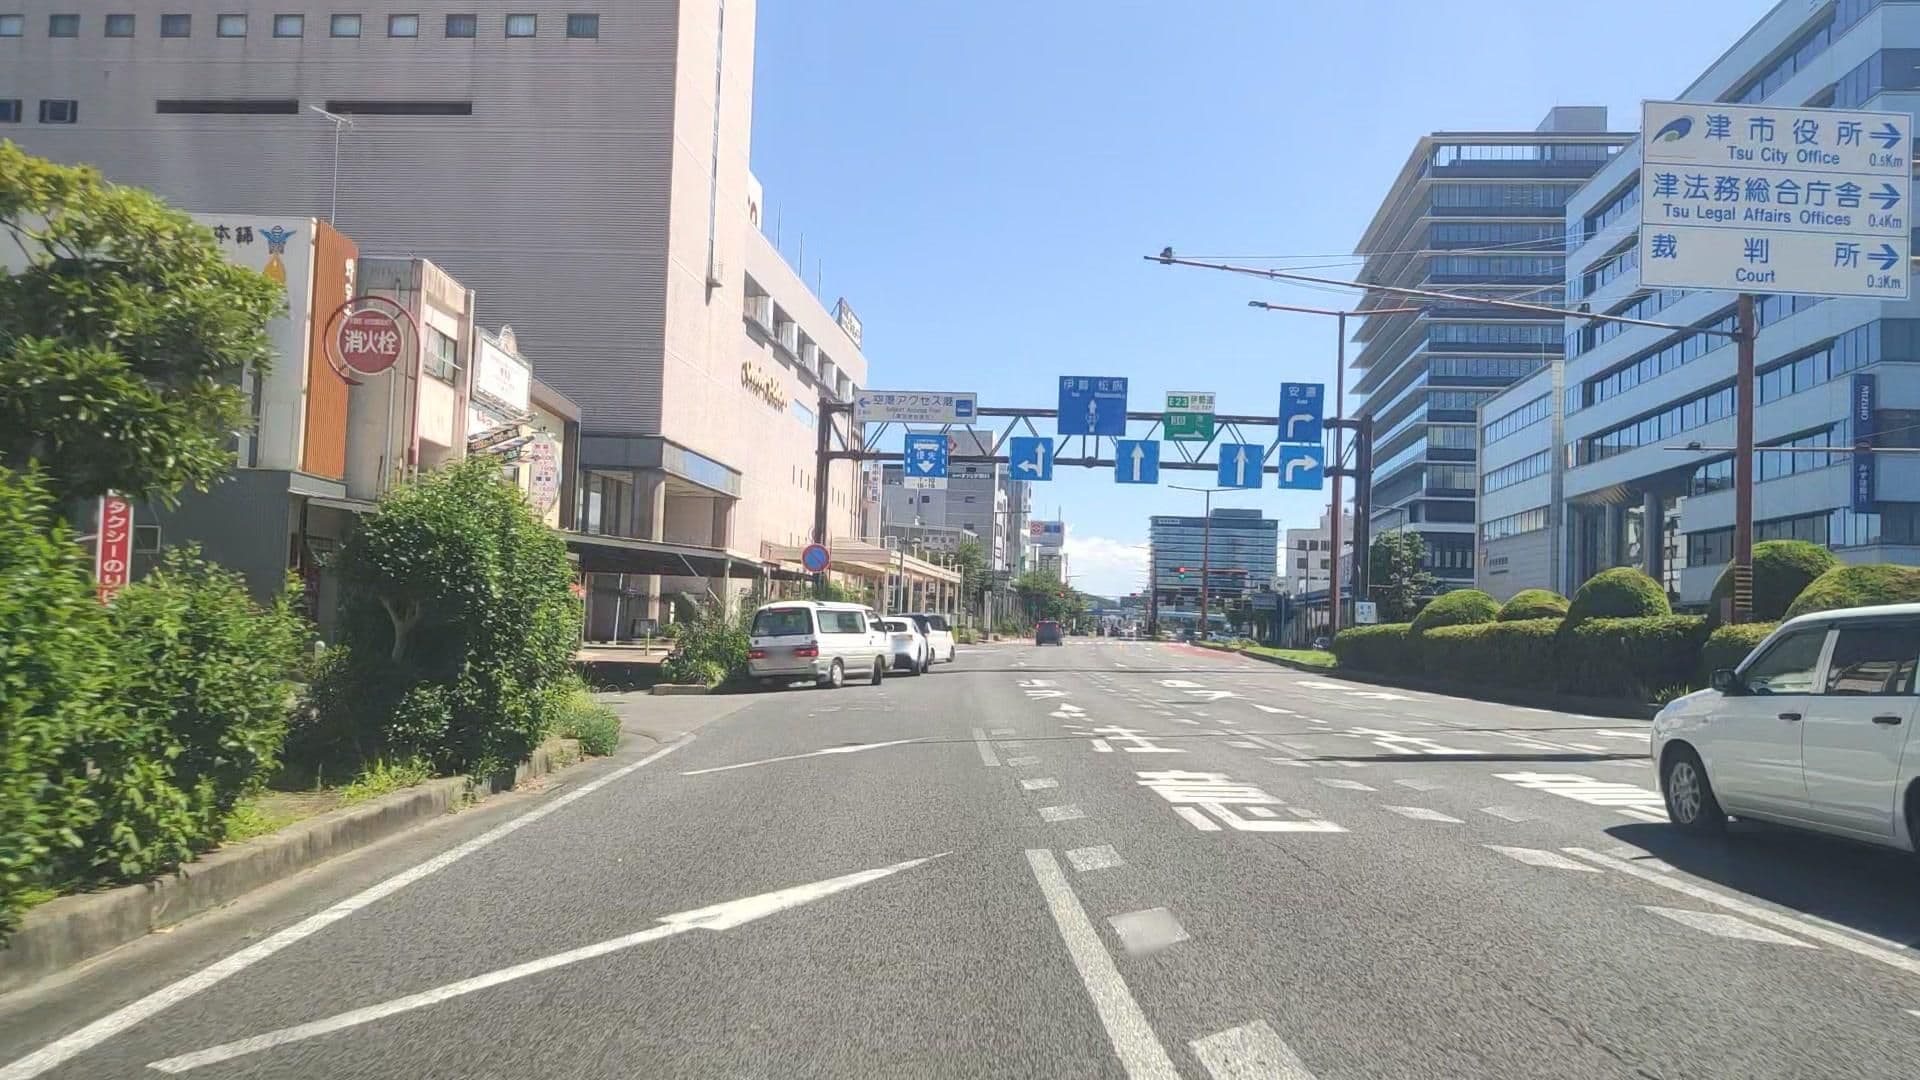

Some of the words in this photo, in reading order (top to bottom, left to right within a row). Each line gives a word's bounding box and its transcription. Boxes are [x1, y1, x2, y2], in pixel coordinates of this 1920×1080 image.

[1704, 113, 1864, 147] 津市役所
[1727, 145, 1753, 161] Tsu
[1760, 147, 1788, 165] City
[1796, 149, 1841, 165] Office
[1869, 153, 1903, 168] 0.5Km
[1652, 172, 1863, 208] 津法務総合庁舎
[1662, 203, 1689, 218] Tsu
[1696, 204, 1736, 222] Legal
[1743, 207, 1792, 224] Affairs
[1799, 210, 1851, 227] Offices
[1868, 214, 1902, 229] 0.4Km
[1651, 233, 1861, 268] 裁判所
[1735, 268, 1775, 283] Court
[1866, 274, 1901, 290] 0.3Km
[344, 329, 398, 355] 消火栓
[1168, 396, 1188, 408] E23
